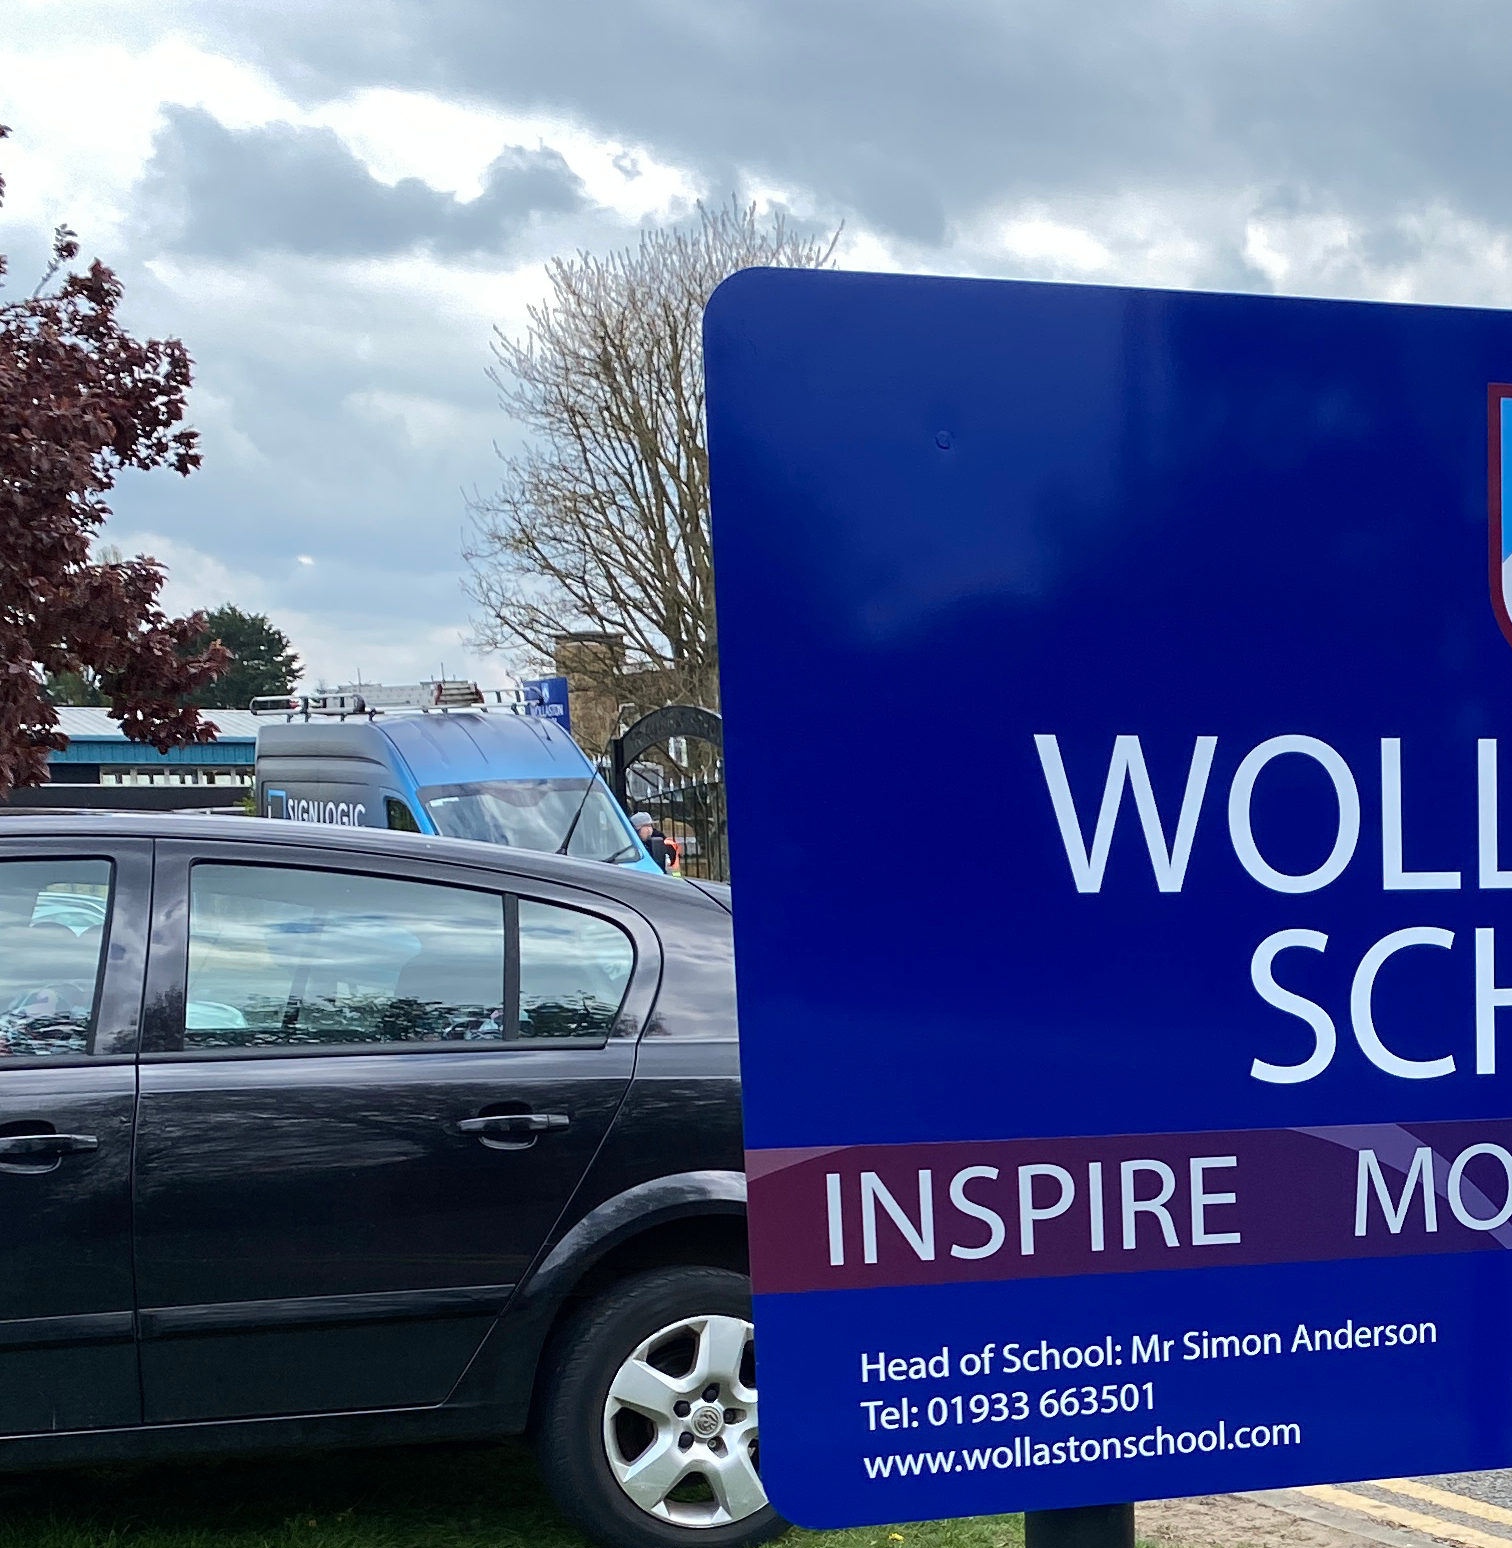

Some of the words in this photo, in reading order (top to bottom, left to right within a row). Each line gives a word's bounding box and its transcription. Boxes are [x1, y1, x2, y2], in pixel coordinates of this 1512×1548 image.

[825, 1155, 1242, 1267] INSPIRE
[861, 1346, 950, 1383] Head
[959, 1343, 996, 1376] of
[1002, 1335, 1122, 1374] School:
[1131, 1334, 1175, 1365] Mr
[1183, 1330, 1282, 1361] Simon
[1290, 1319, 1437, 1353] Anderson
[860, 1397, 919, 1431] Tel:
[927, 1391, 1030, 1426] 01933
[1039, 1382, 1155, 1418] 663501
[863, 1420, 1301, 1479] www.wollastonschool.com
